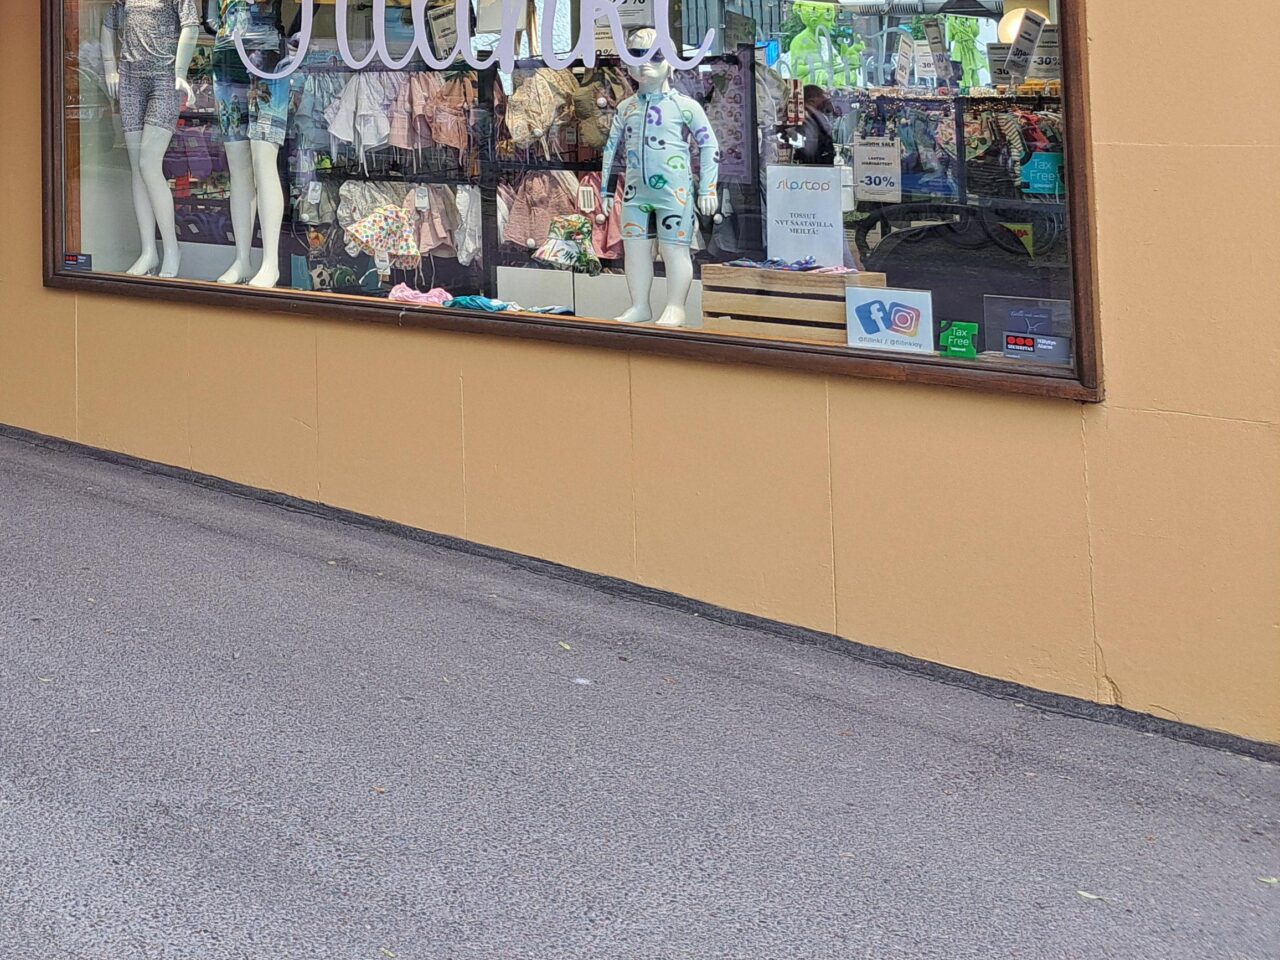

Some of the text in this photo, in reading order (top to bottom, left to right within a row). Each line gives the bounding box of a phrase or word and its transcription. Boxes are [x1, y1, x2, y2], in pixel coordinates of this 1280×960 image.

[1033, 159, 1052, 170] Tax
[1029, 170, 1056, 181] Free
[859, 175, 895, 187] -30%
[790, 212, 817, 220] TOSSUT
[790, 220, 834, 228] SAATAVILLA
[952, 327, 968, 336] Tax
[948, 336, 969, 346] Free
